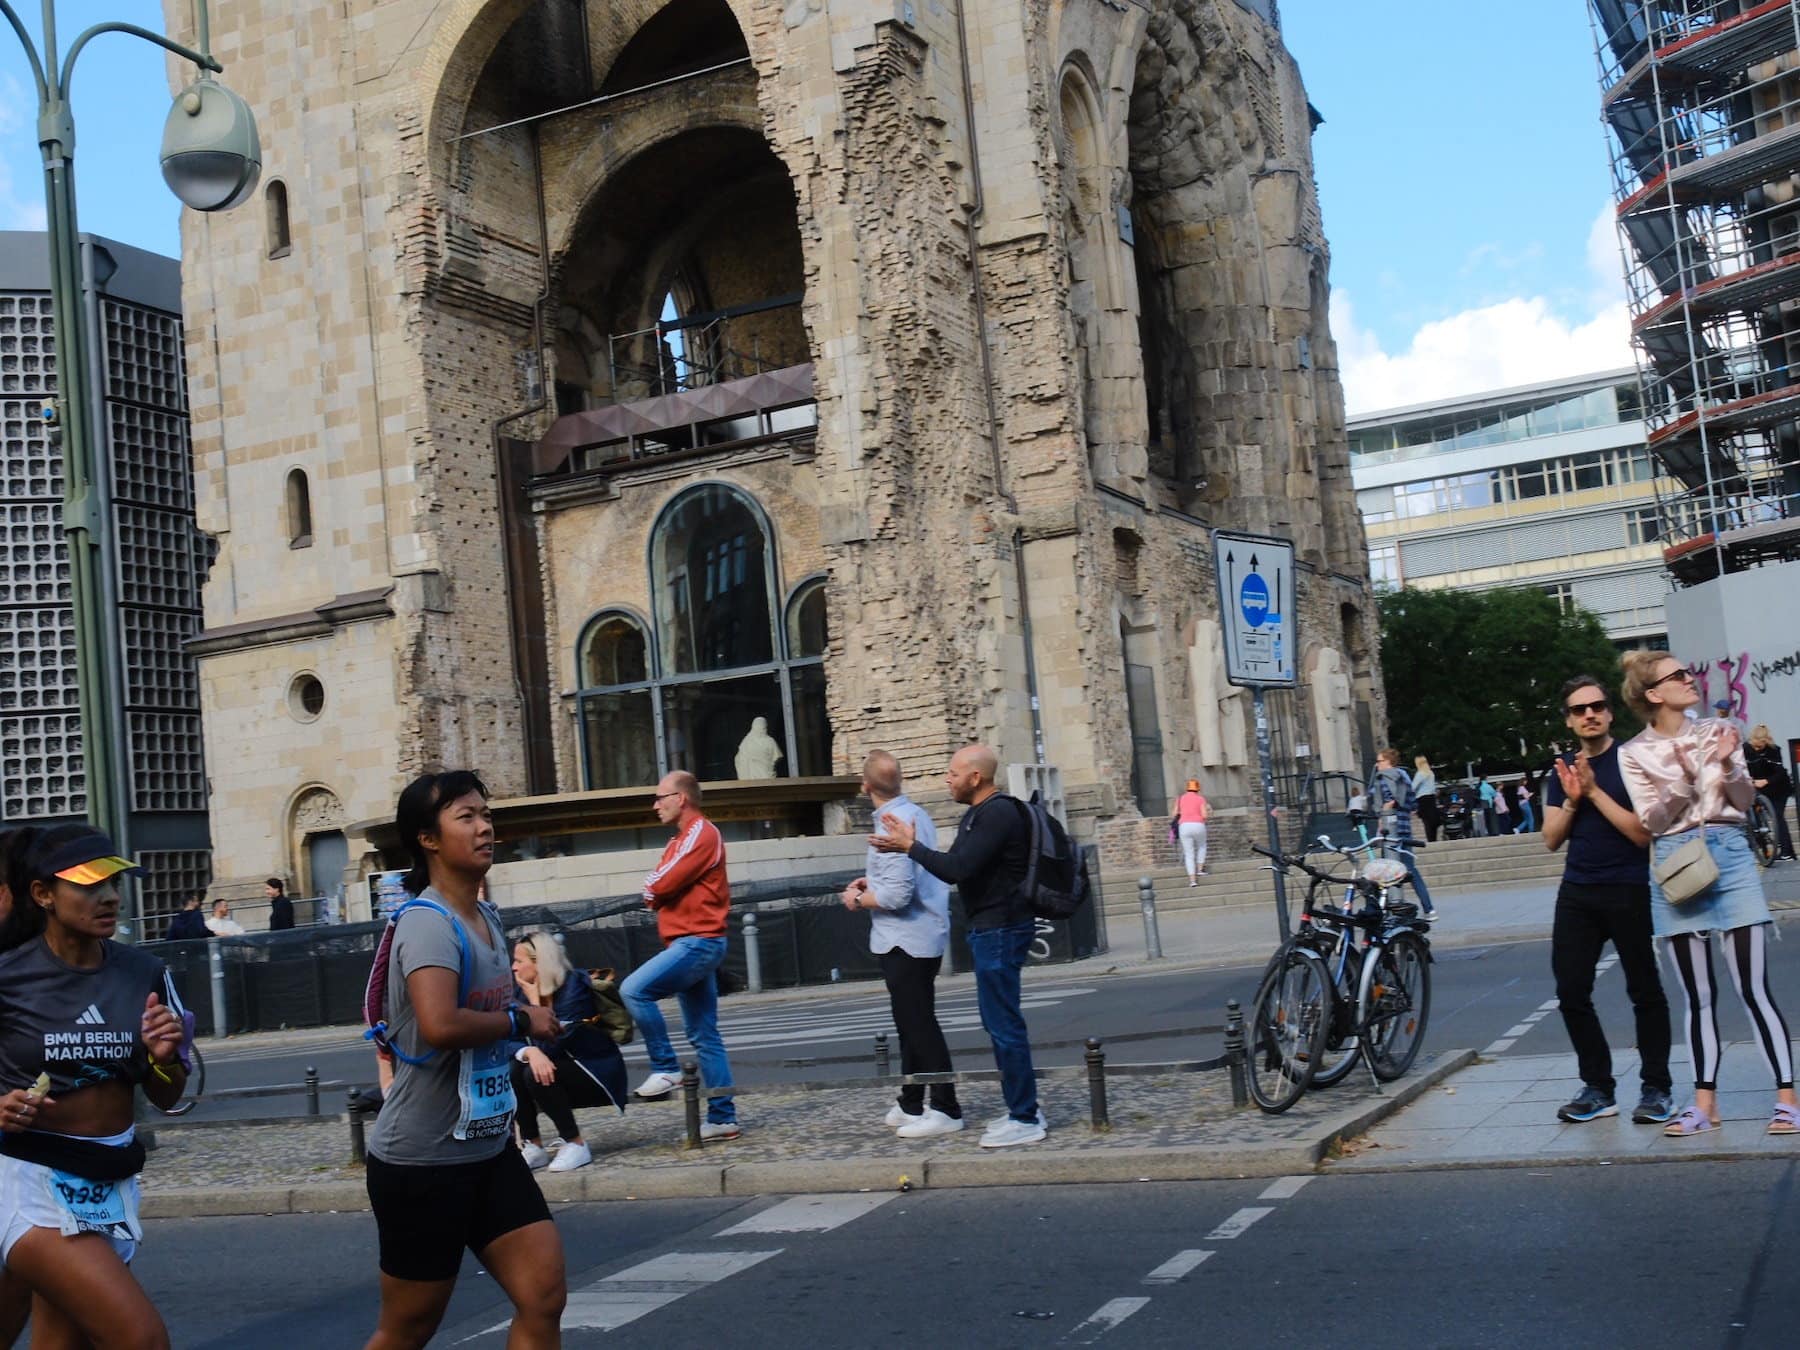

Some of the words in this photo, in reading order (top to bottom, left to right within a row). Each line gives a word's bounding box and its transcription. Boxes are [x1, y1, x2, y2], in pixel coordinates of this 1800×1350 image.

[44, 1032, 82, 1046] BMW
[85, 1031, 133, 1044] BERLIN
[44, 1046, 133, 1061] MARATHON
[475, 1072, 510, 1098] 1836
